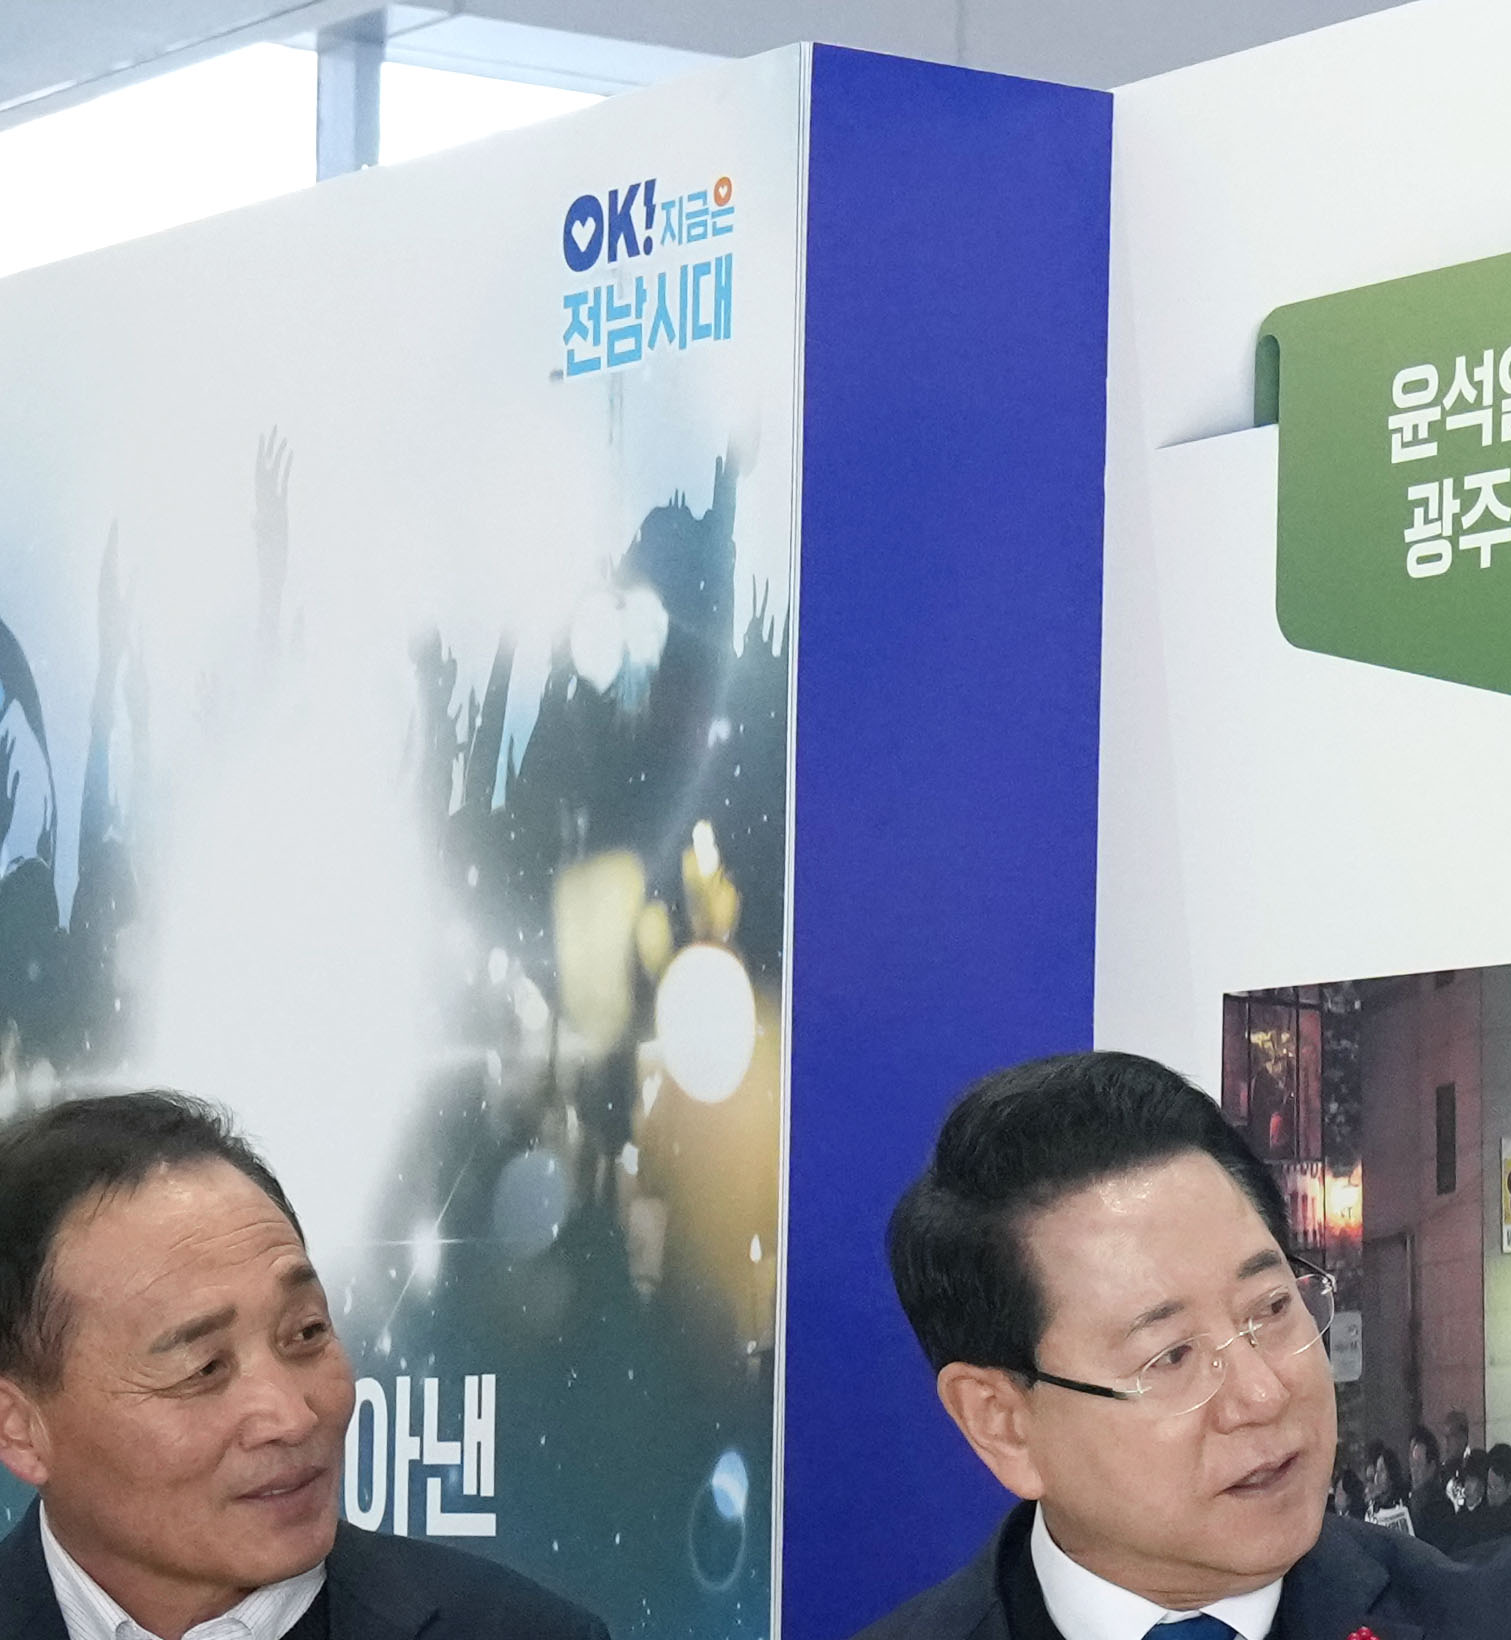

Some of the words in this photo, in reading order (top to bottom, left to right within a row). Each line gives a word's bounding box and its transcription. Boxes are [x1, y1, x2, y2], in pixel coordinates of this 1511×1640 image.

[563, 178, 657, 272] OK!
[660, 176, 735, 246] 지금은
[563, 253, 733, 376] 전남시대
